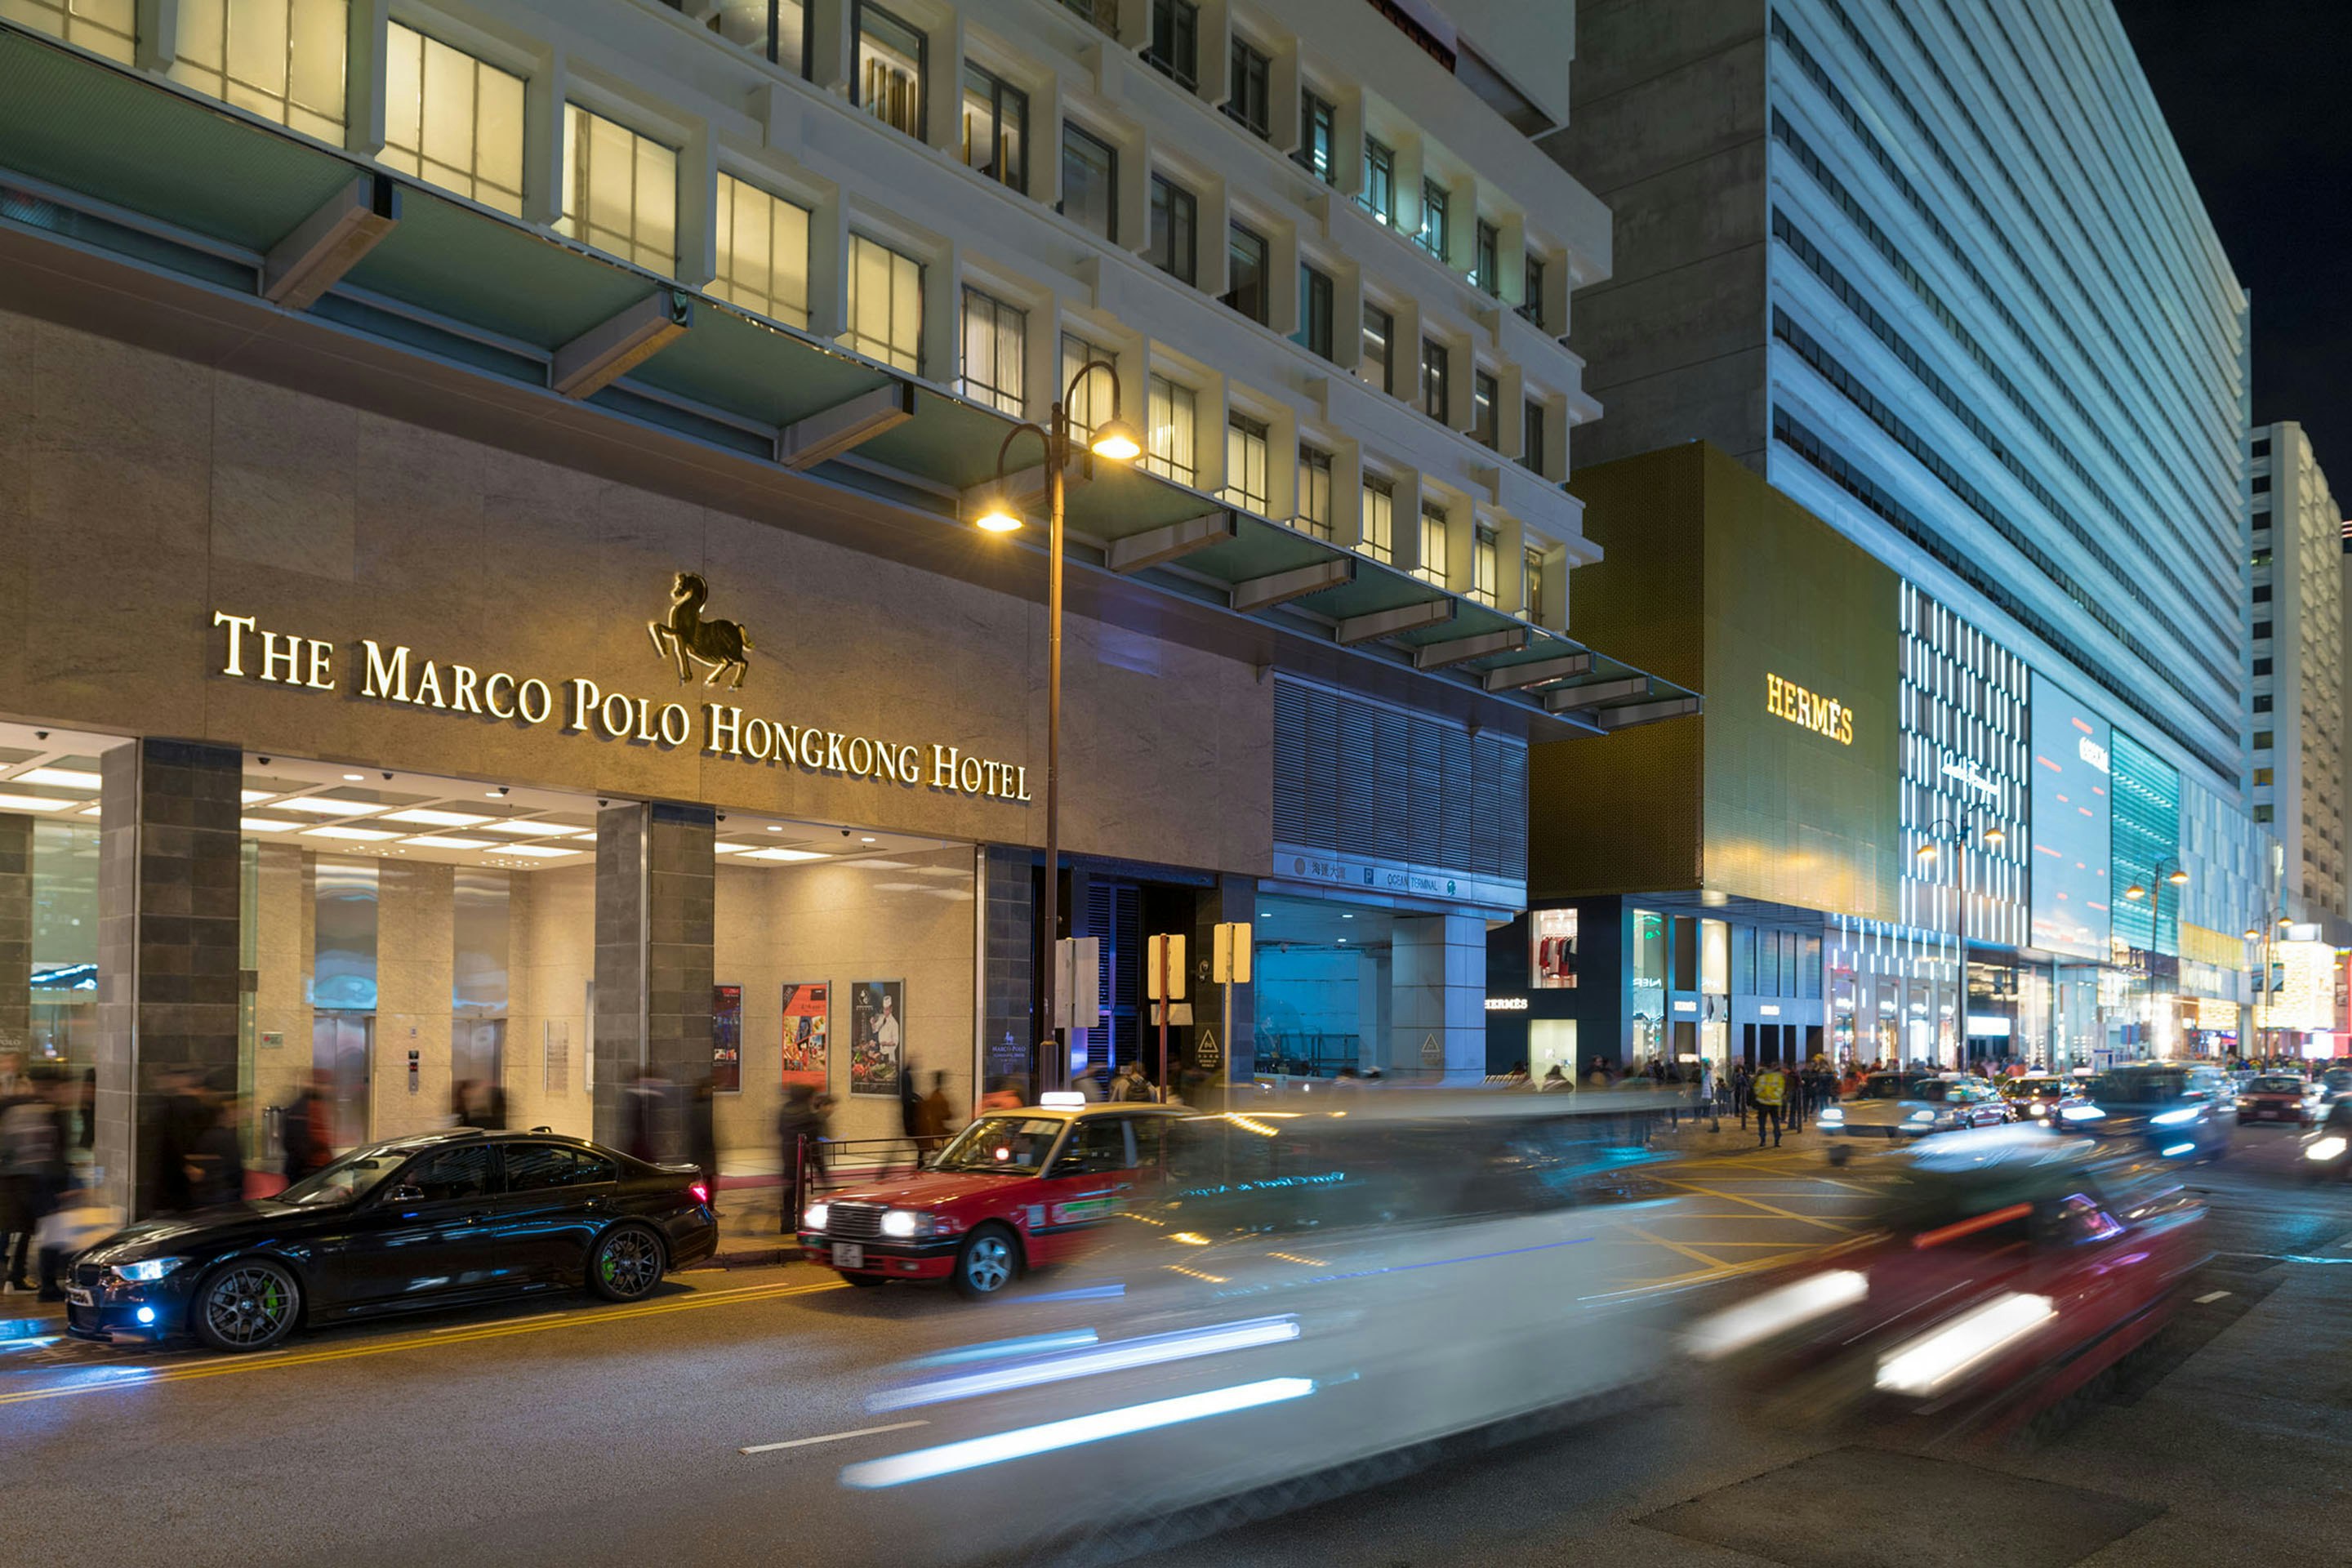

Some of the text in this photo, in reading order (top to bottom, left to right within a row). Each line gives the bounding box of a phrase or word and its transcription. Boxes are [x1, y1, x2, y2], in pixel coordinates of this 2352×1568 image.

[214, 610, 1031, 801] THE MARCO POLO HONGKONG HOTEL
[1766, 673, 1853, 745] HERMÈS
[1388, 874, 1437, 891] OCEAN TERMINAL
